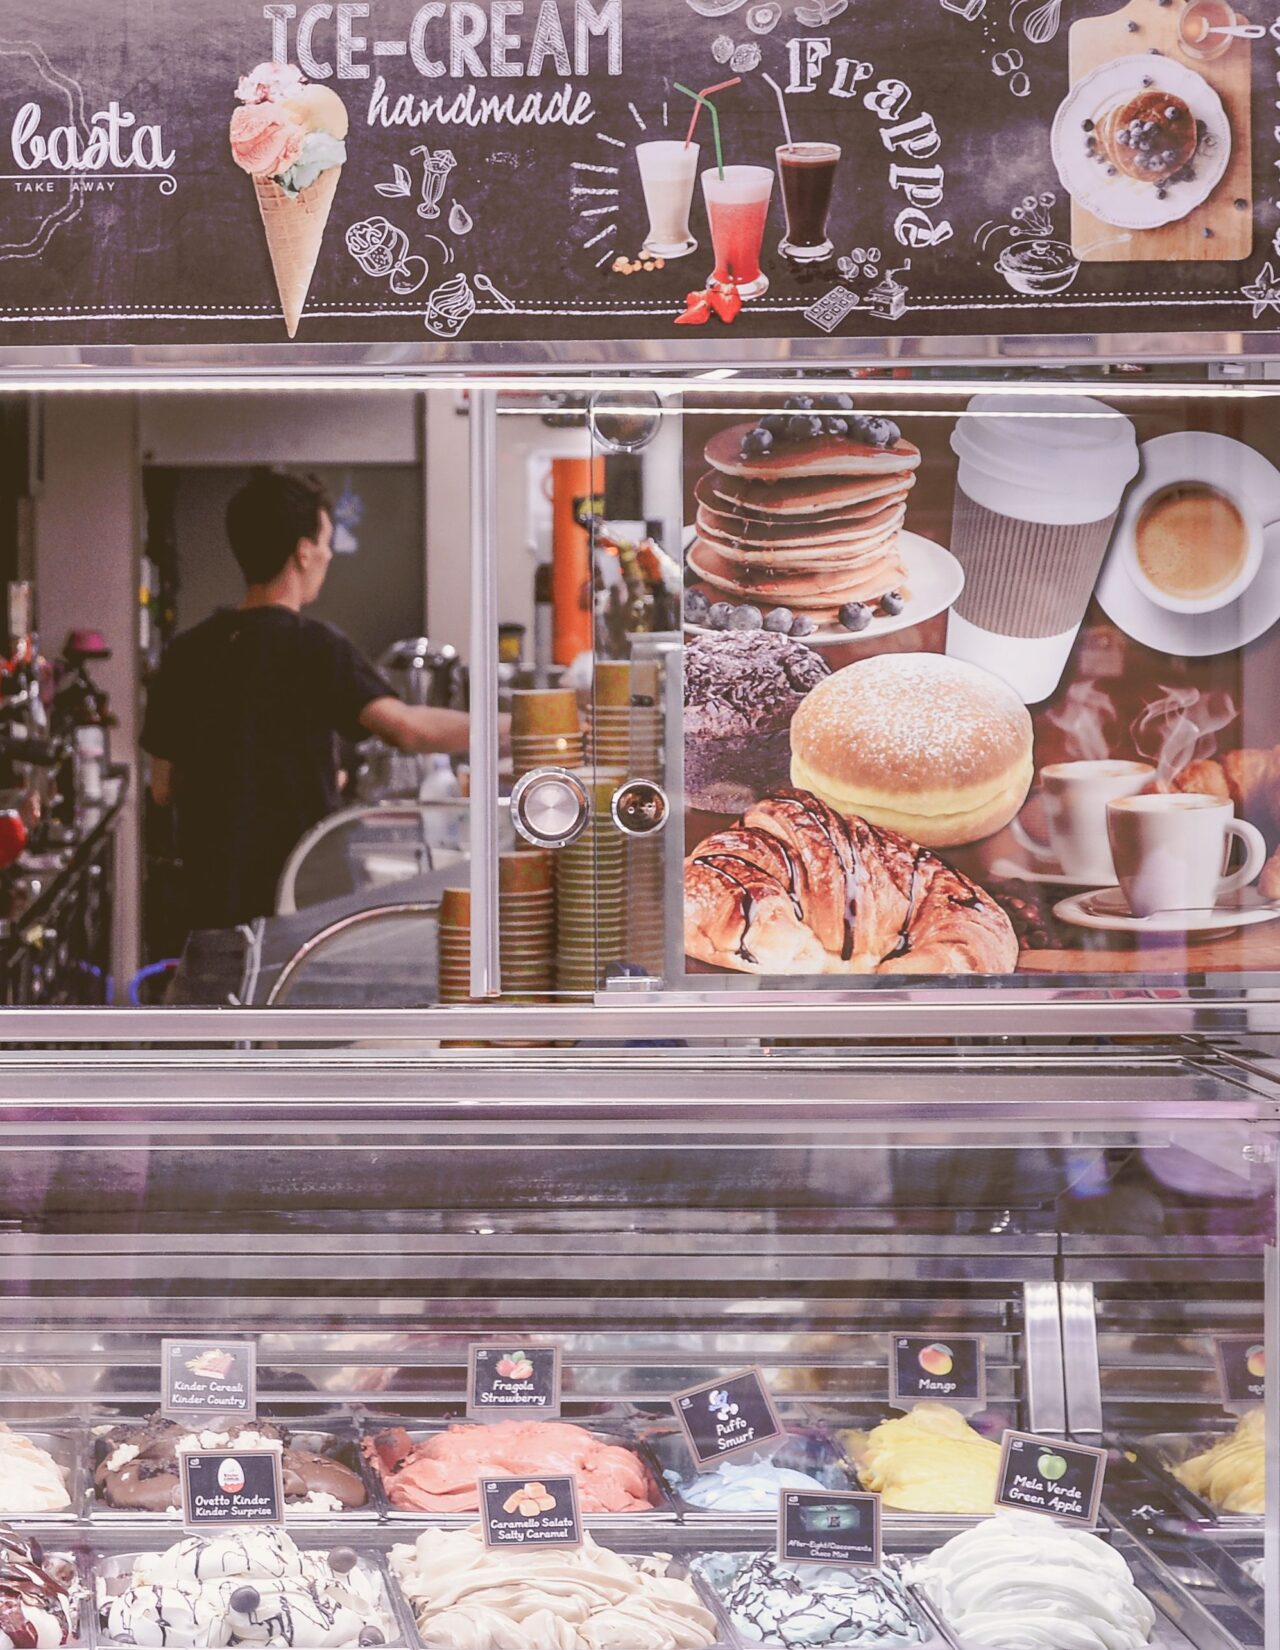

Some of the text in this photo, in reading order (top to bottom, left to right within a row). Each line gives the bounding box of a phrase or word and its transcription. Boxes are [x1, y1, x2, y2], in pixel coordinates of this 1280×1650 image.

[264, 0, 623, 79] ICE-CREAM
[367, 75, 596, 128] handmade
[11, 101, 176, 171] basta
[784, 37, 953, 249] Frappè
[15, 181, 55, 193] TAKE
[72, 181, 116, 193] AWAY
[174, 1381, 207, 1391] Kinder
[493, 1380, 534, 1392] Fragola
[918, 1378, 956, 1393] Mango
[172, 1394, 246, 1408] Kinder Country
[481, 1392, 546, 1406] Strawberry
[716, 1417, 747, 1436] Puffo
[718, 1427, 754, 1450] Smurf
[1013, 1475, 1082, 1499] Mela Verde
[195, 1494, 271, 1506] Ovetto Kinder
[1009, 1488, 1082, 1513] Green Apple
[196, 1506, 272, 1518] Kinder Surprise
[490, 1517, 573, 1530] Caramello Salato
[498, 1528, 568, 1542] Salty Caramel
